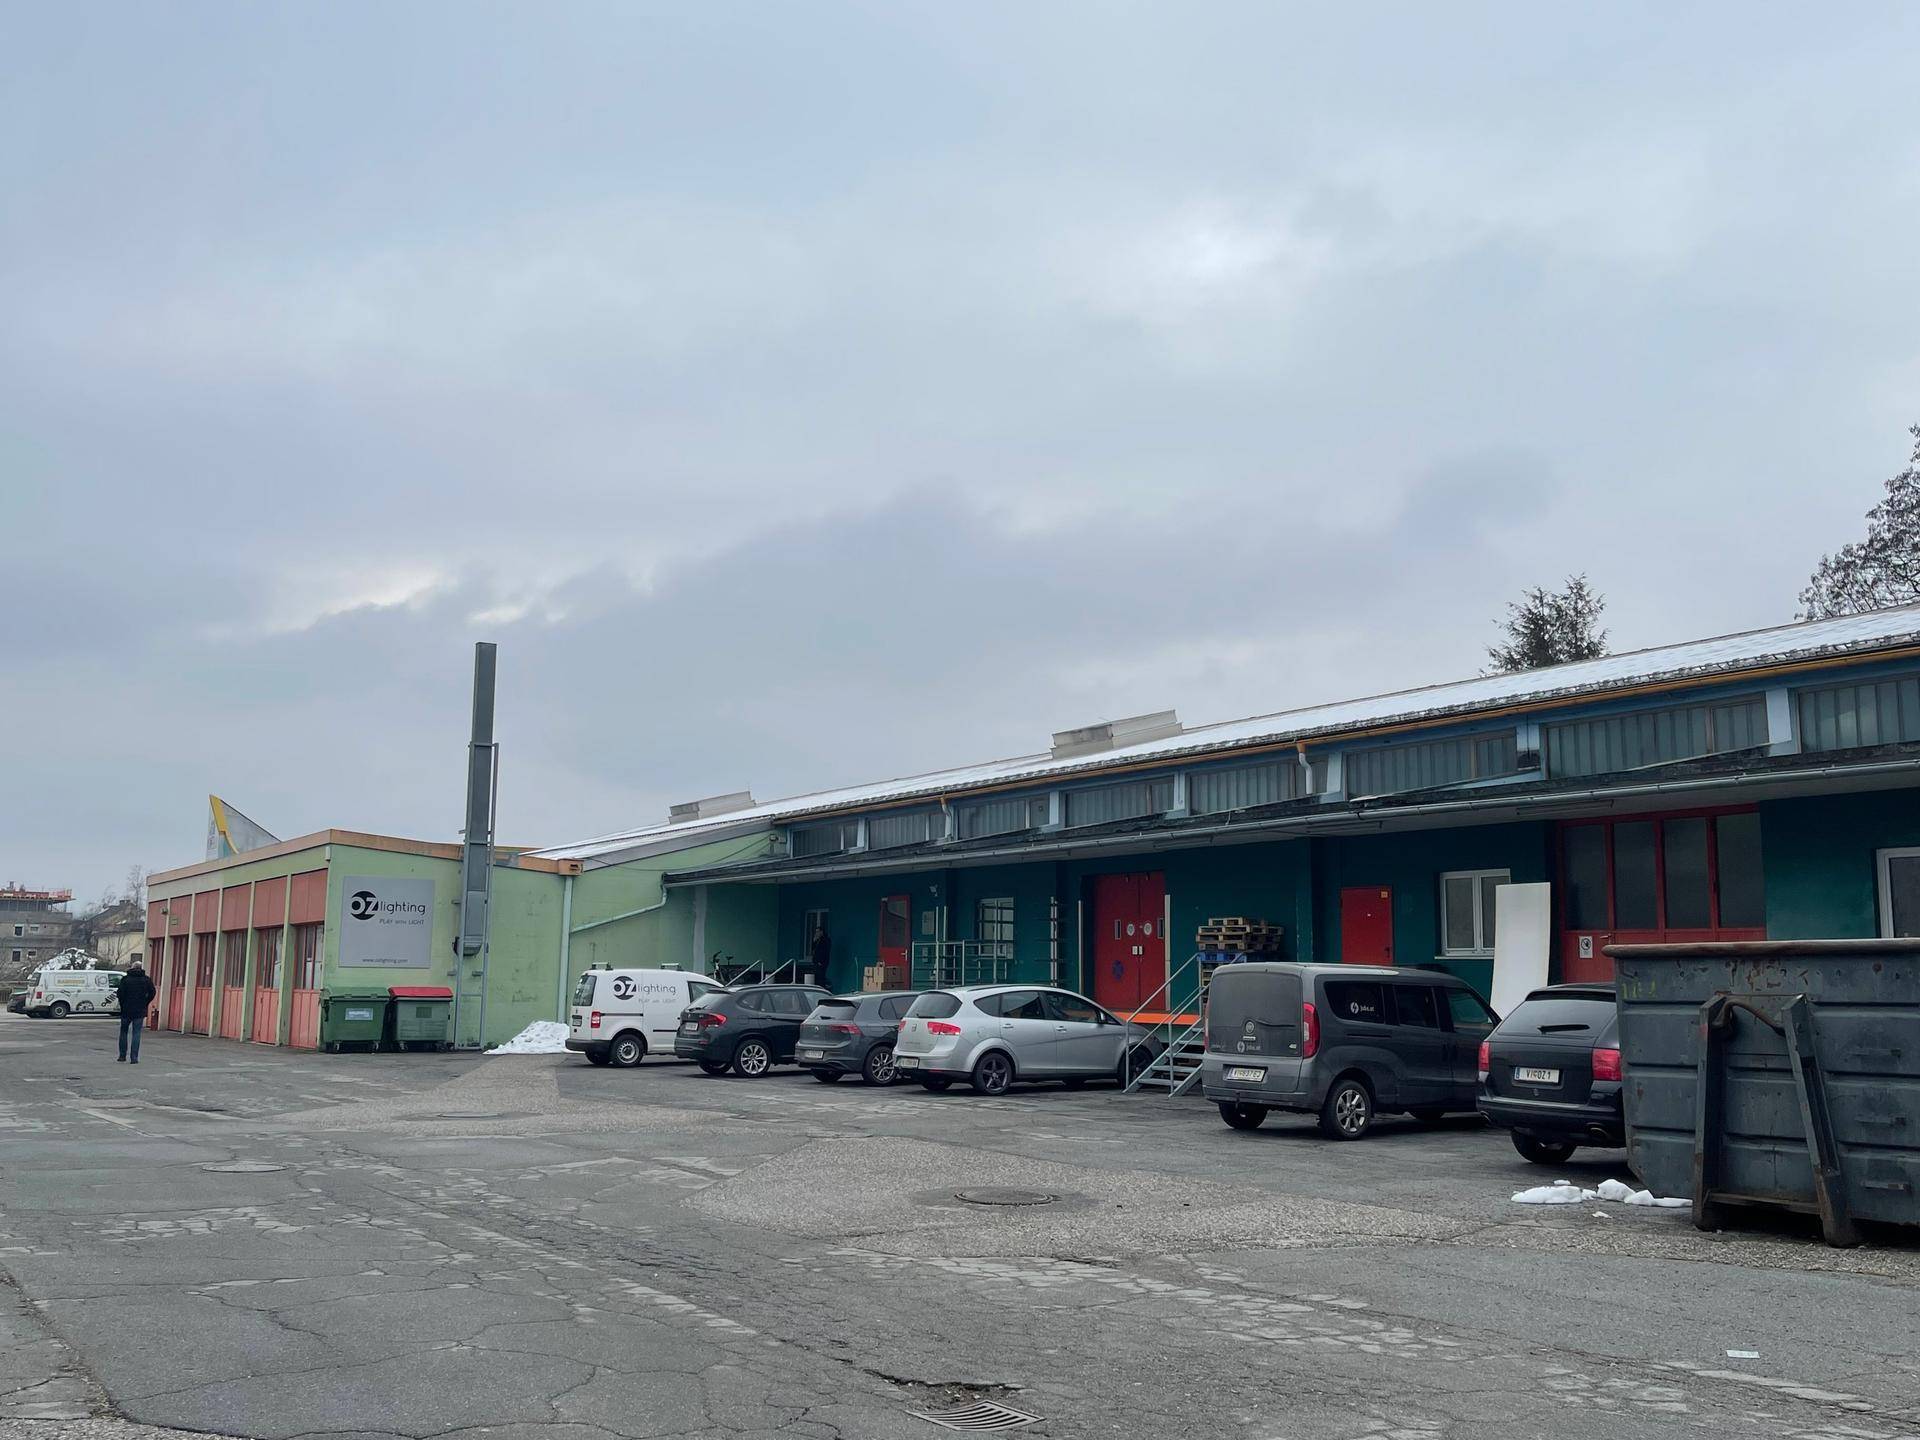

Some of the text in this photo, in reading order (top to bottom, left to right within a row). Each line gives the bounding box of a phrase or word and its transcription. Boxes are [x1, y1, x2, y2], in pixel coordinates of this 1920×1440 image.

[350, 893, 426, 917] OZ lighting
[638, 984, 676, 995] lighting
